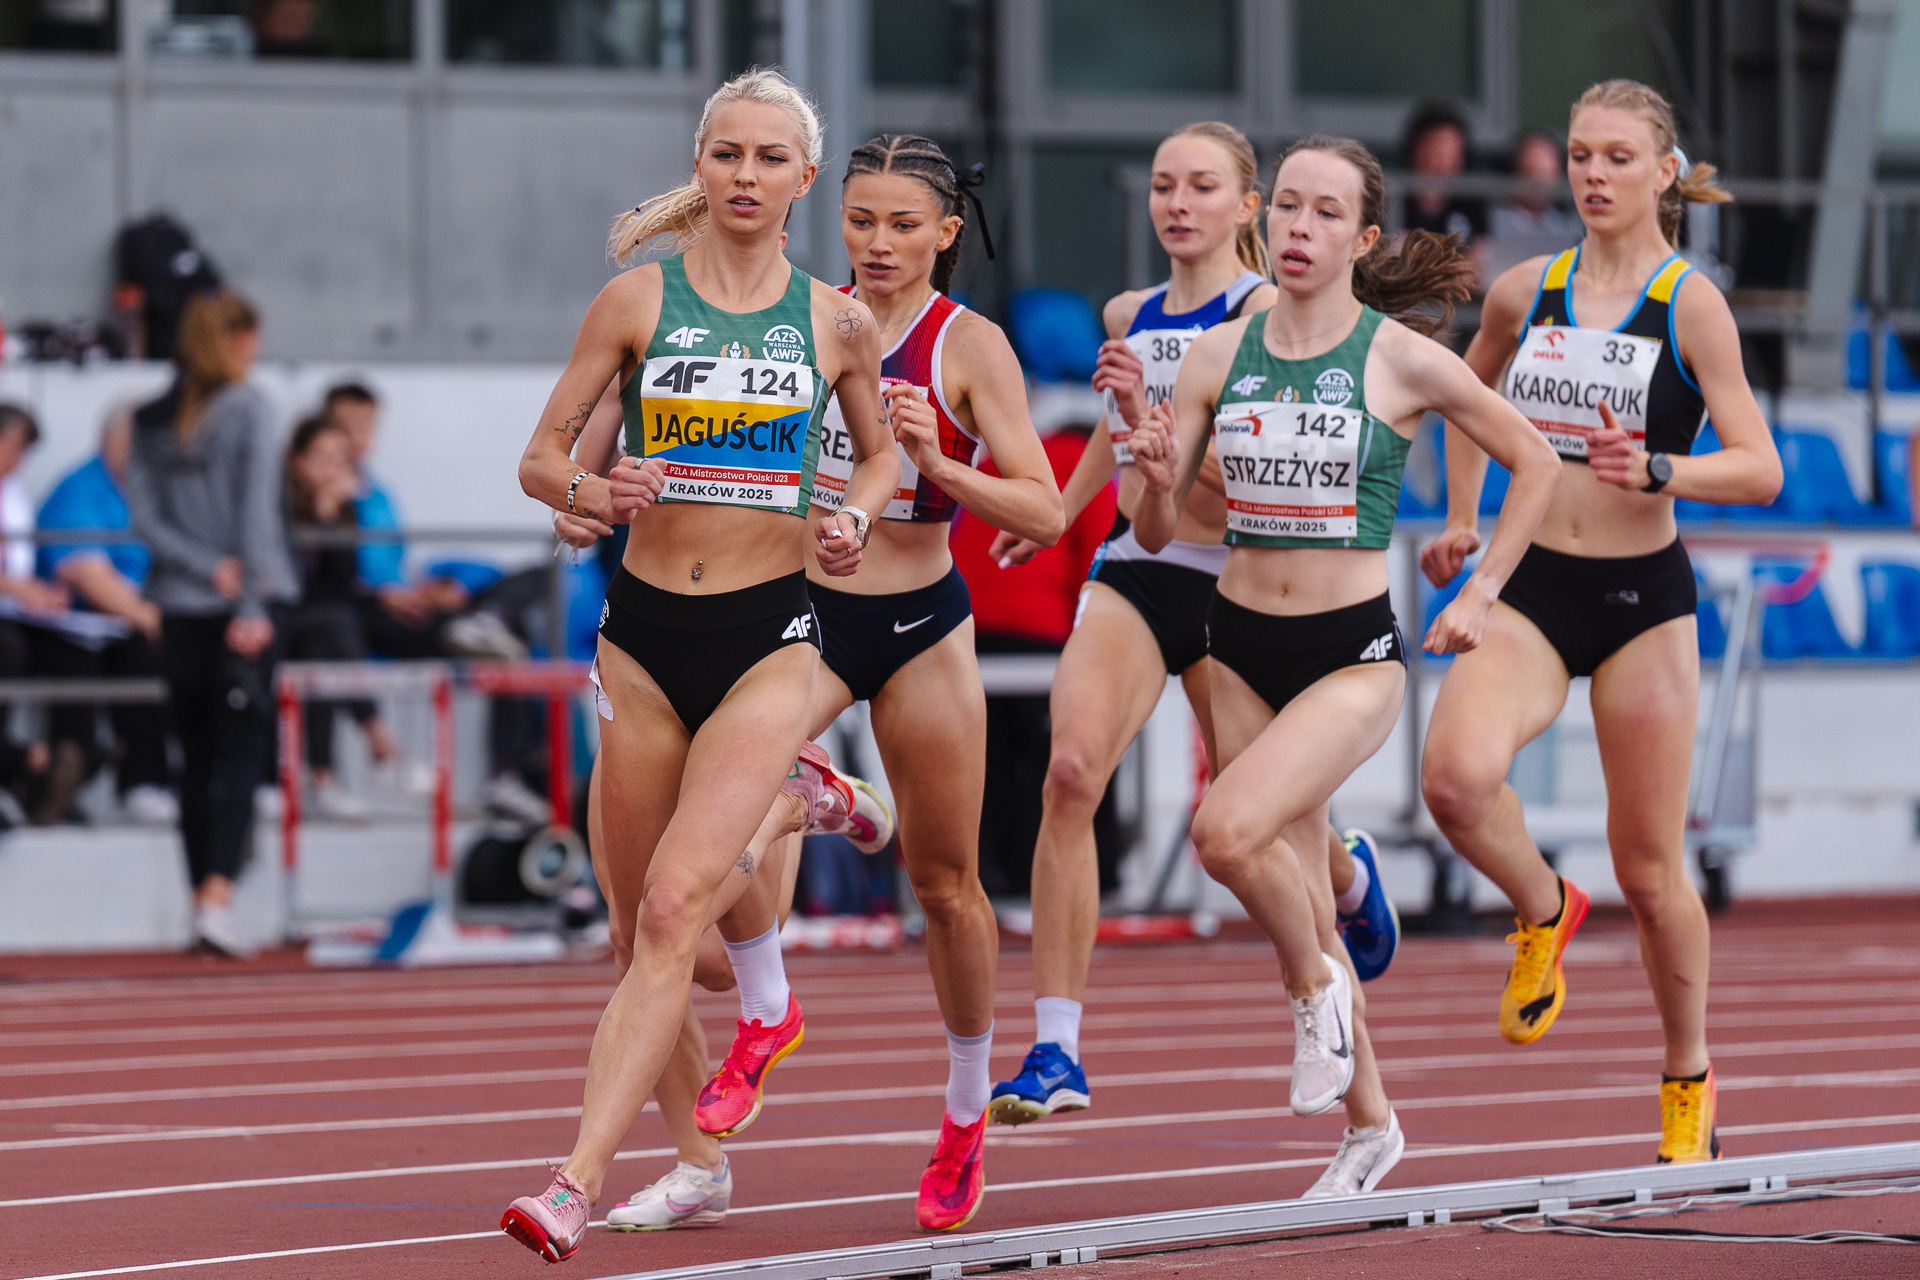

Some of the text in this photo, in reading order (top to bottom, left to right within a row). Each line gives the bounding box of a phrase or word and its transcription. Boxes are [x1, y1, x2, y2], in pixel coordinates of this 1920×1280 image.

[665, 326, 710, 349] 4F
[768, 342, 801, 350] WARSZAWA
[771, 331, 797, 344] AZS
[770, 348, 799, 361] AWF
[1602, 340, 1636, 365] 33
[652, 361, 799, 397] 4F 124
[1231, 374, 1267, 397] 4F
[1324, 374, 1347, 386] AZS
[1319, 390, 1347, 402] AWF
[1512, 372, 1643, 416] KAROLCZUK
[651, 412, 800, 454] JAGUŚCIK
[1219, 411, 1347, 438] polanik 142
[669, 466, 688, 476] PZLA
[690, 468, 744, 480] Mistrzostwa
[746, 473, 773, 482] Polski
[774, 474, 789, 483] U23
[1222, 451, 1350, 487] STRZEŻYSZ
[669, 482, 773, 500] KRAKÓW 2025
[1254, 505, 1300, 516] Mistrzostwa
[1301, 507, 1326, 516] Polski
[1327, 506, 1344, 515] U23
[1240, 517, 1327, 532] KRAKÓW 2025
[781, 613, 812, 640] 4F
[1360, 633, 1393, 661] 4F
